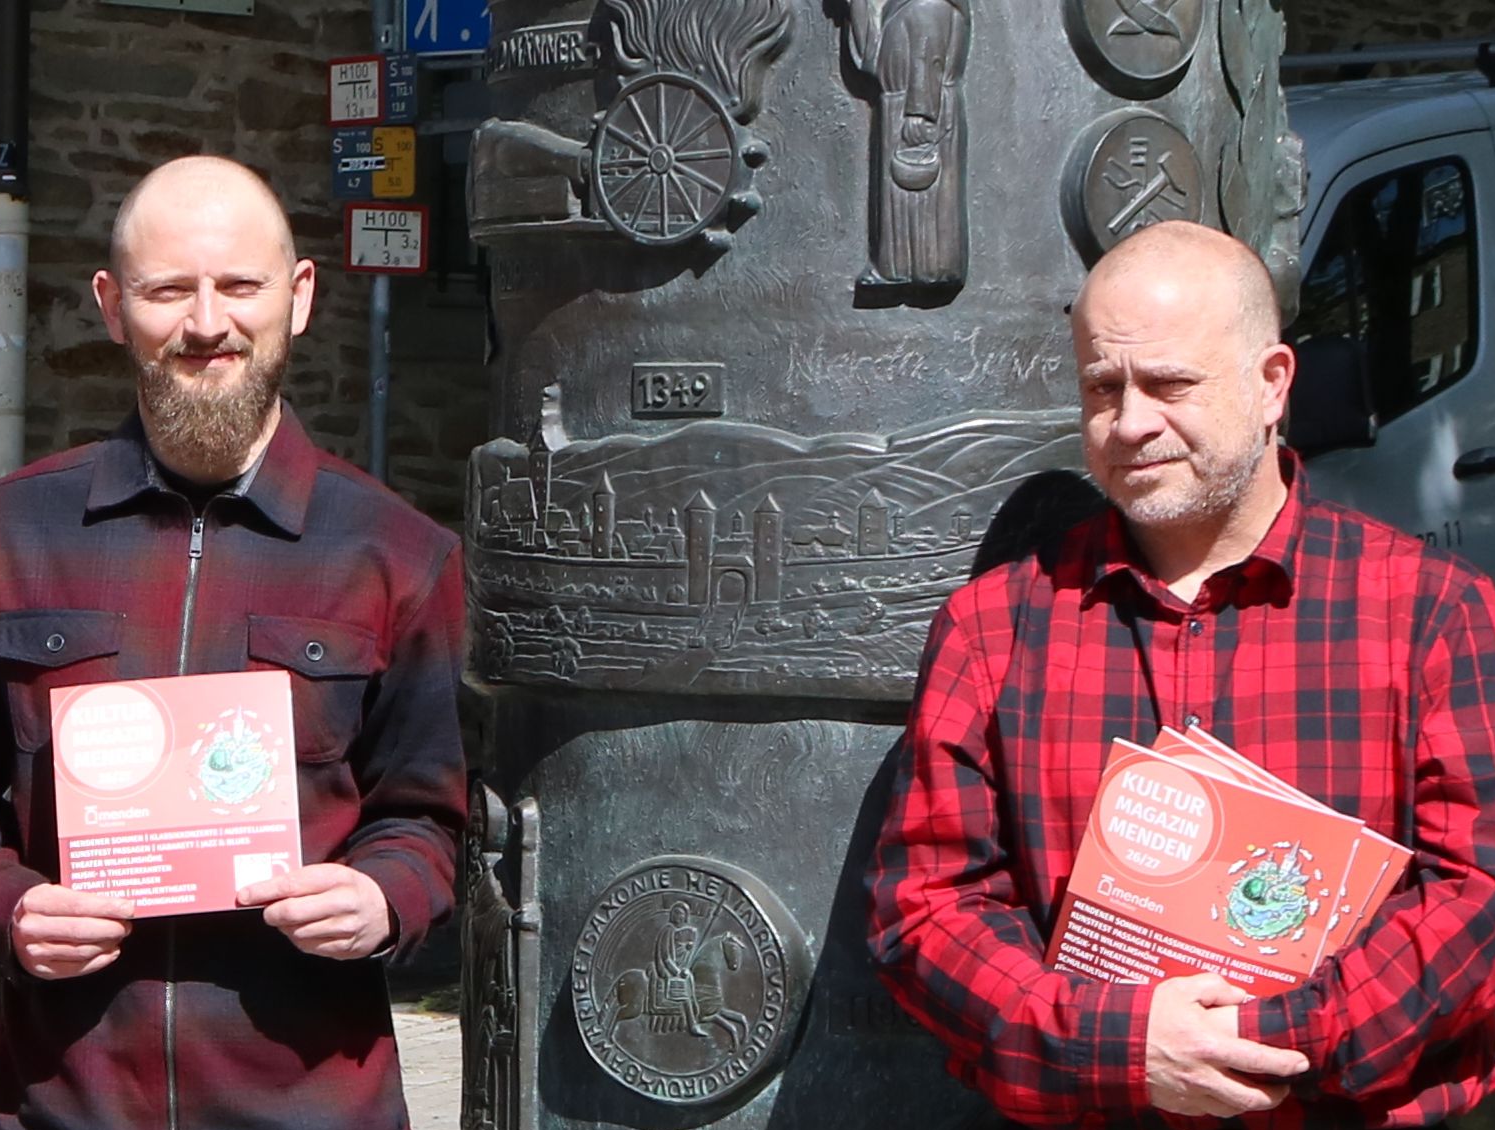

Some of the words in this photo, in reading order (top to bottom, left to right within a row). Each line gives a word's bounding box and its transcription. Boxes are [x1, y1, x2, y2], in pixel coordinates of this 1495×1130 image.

[637, 372, 711, 410] 1349
[1120, 770, 1207, 817] KULTUR
[1114, 795, 1200, 839] MAGAZIN
[1107, 816, 1193, 861] MENDEN
[1125, 848, 1162, 869] 26/27
[1073, 898, 1114, 923] MENDENER
[1115, 915, 1148, 938] SOMMER
[1111, 885, 1165, 915] menden
[1067, 920, 1100, 943] THEATER
[1070, 909, 1112, 934] KUNSTFEST
[1112, 924, 1152, 950] PASSAGEN
[1060, 942, 1096, 964] GUTSART
